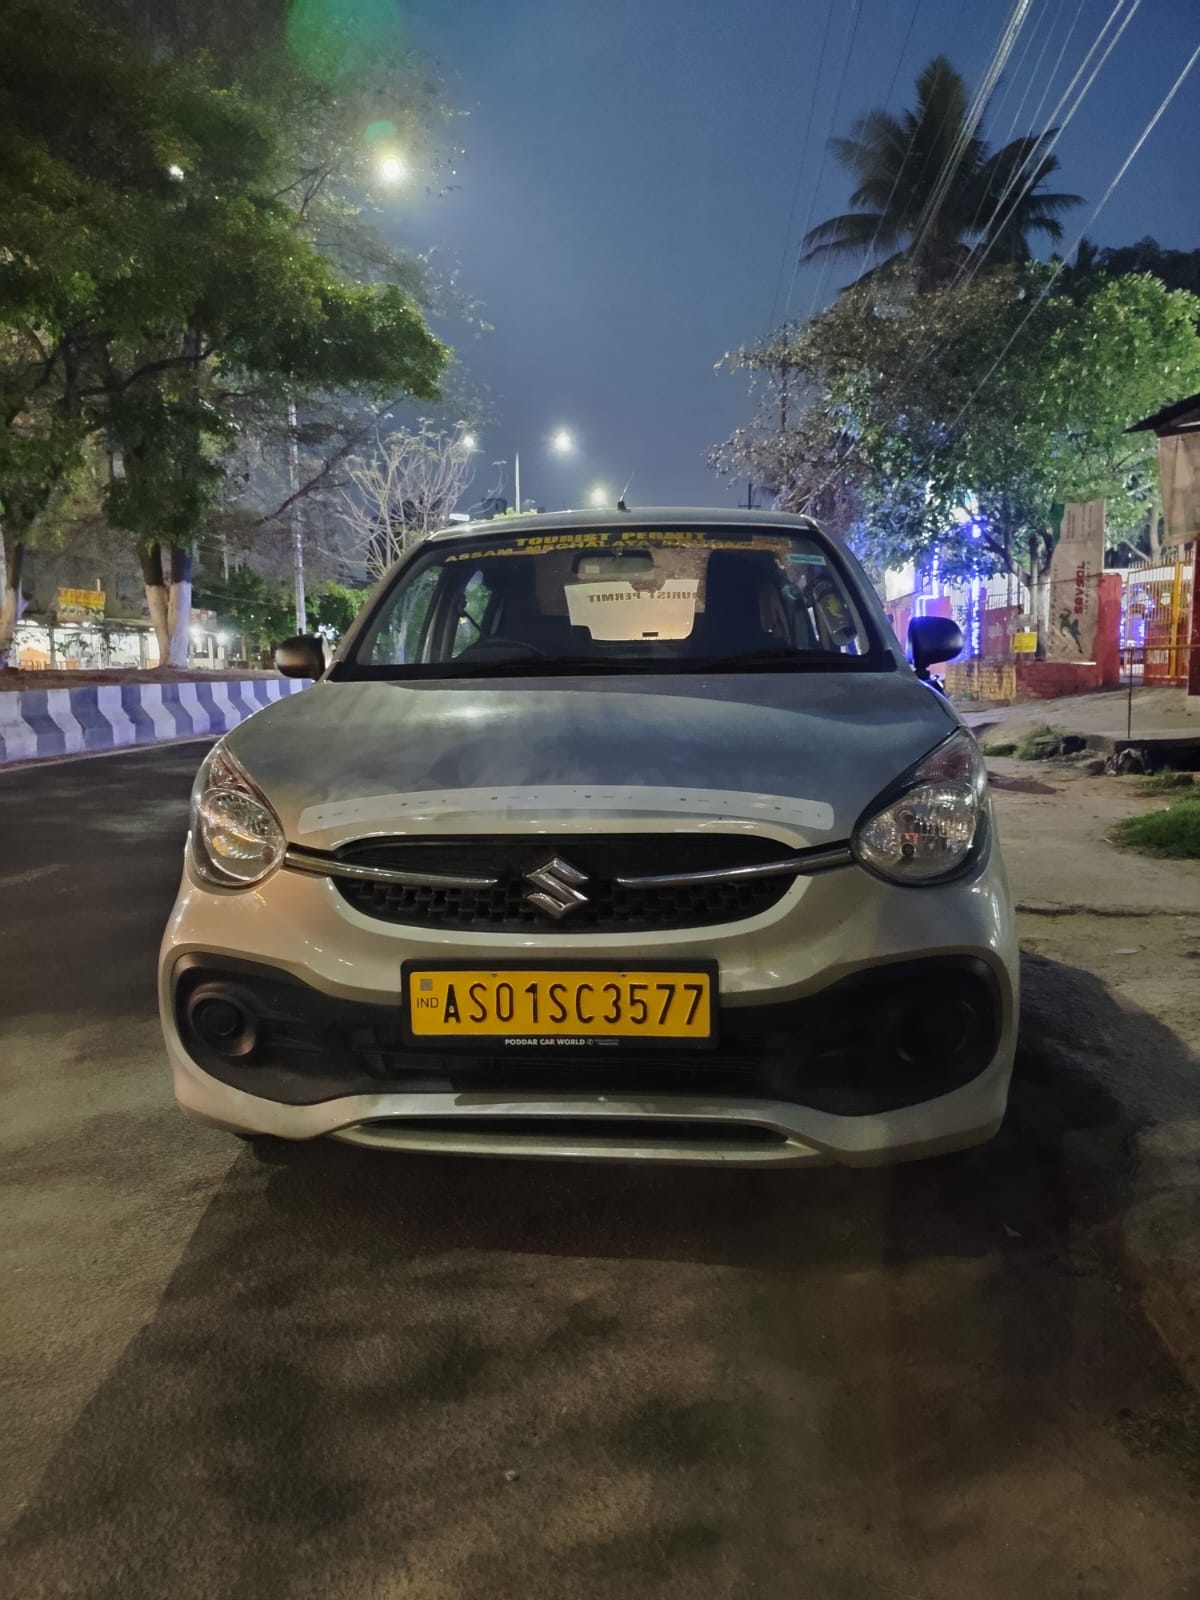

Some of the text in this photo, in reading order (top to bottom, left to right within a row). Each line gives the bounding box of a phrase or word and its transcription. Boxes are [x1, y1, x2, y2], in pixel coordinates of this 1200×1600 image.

[515, 531, 705, 547] TOURIST PERMIT
[445, 548, 513, 563] ASSAM
[1073, 561, 1086, 616] SAVSOL
[416, 982, 703, 1025] IND AS01SC3577
[504, 1038, 538, 1046] PODDAR
[539, 1038, 556, 1046] CAR
[557, 1038, 586, 1046] WORLD
